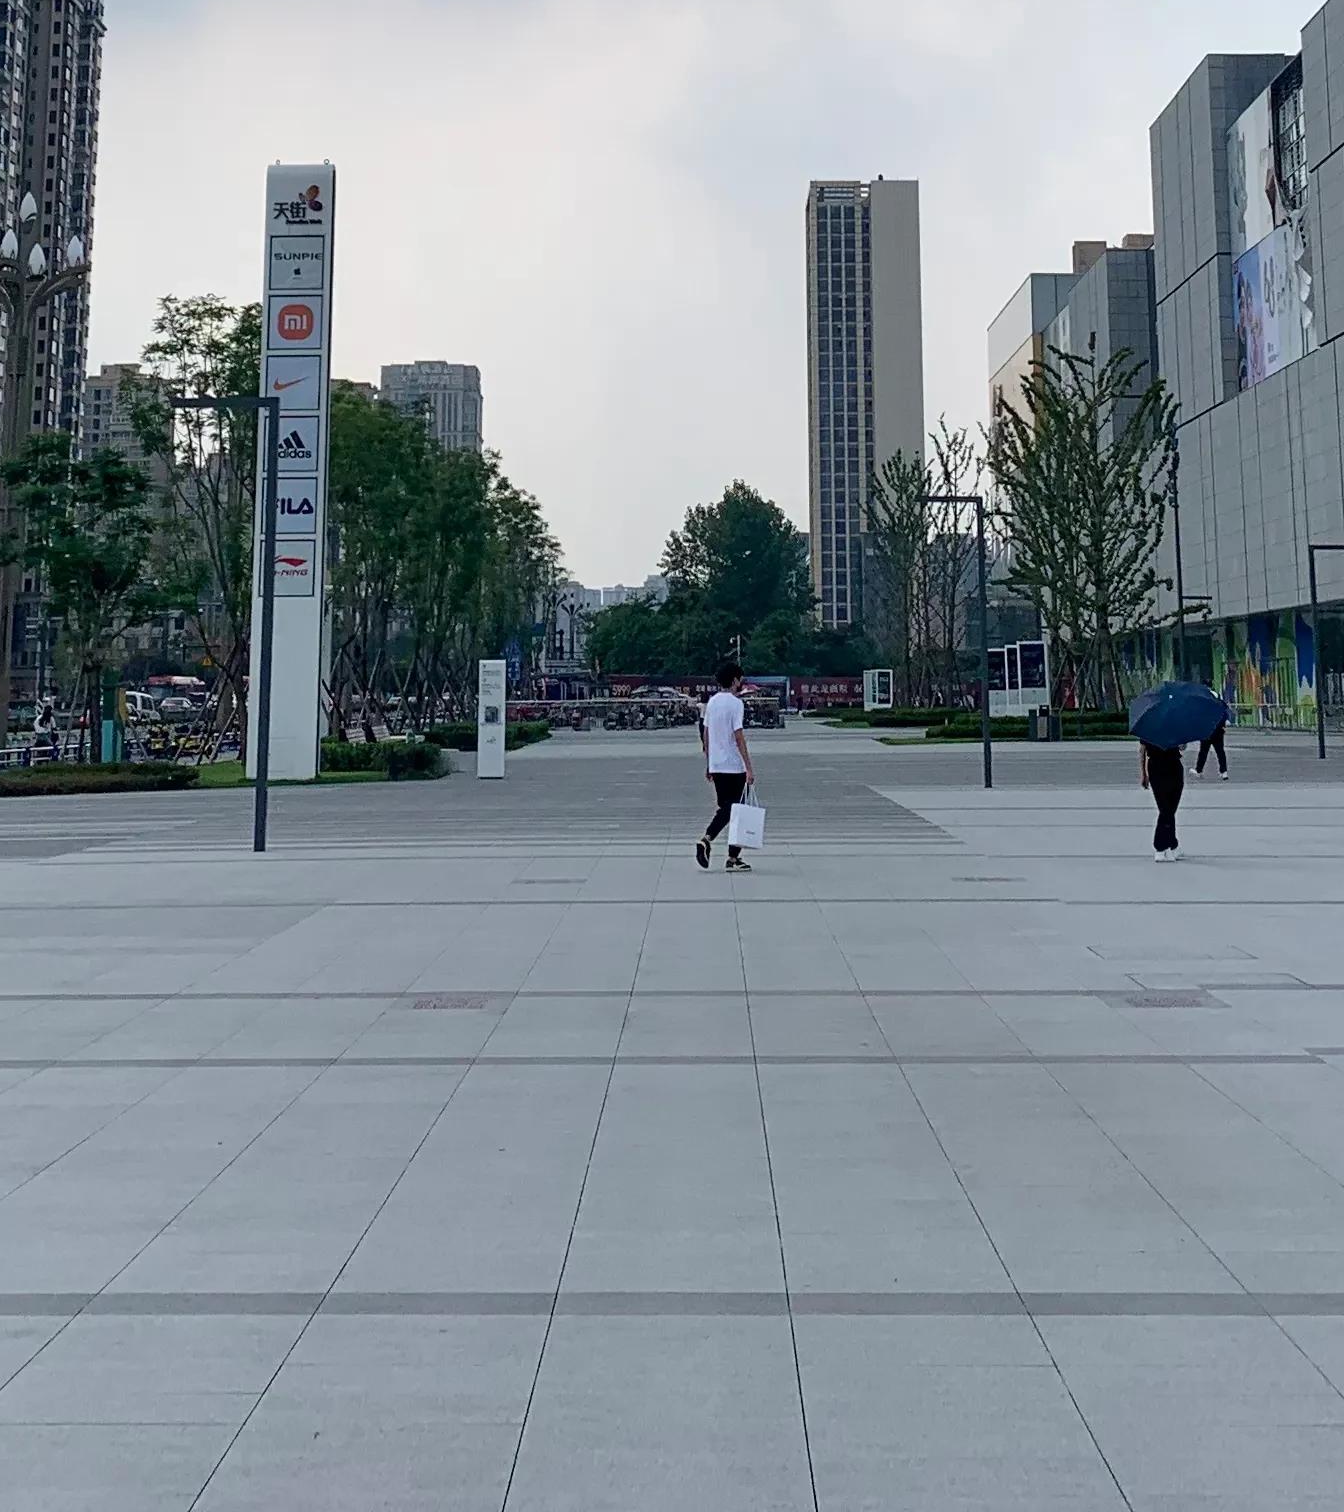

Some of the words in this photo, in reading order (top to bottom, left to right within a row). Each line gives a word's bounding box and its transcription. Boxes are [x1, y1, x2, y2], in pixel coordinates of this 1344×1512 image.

[273, 201, 306, 219] 天街
[277, 448, 312, 459] didas
[275, 498, 314, 515] ILA
